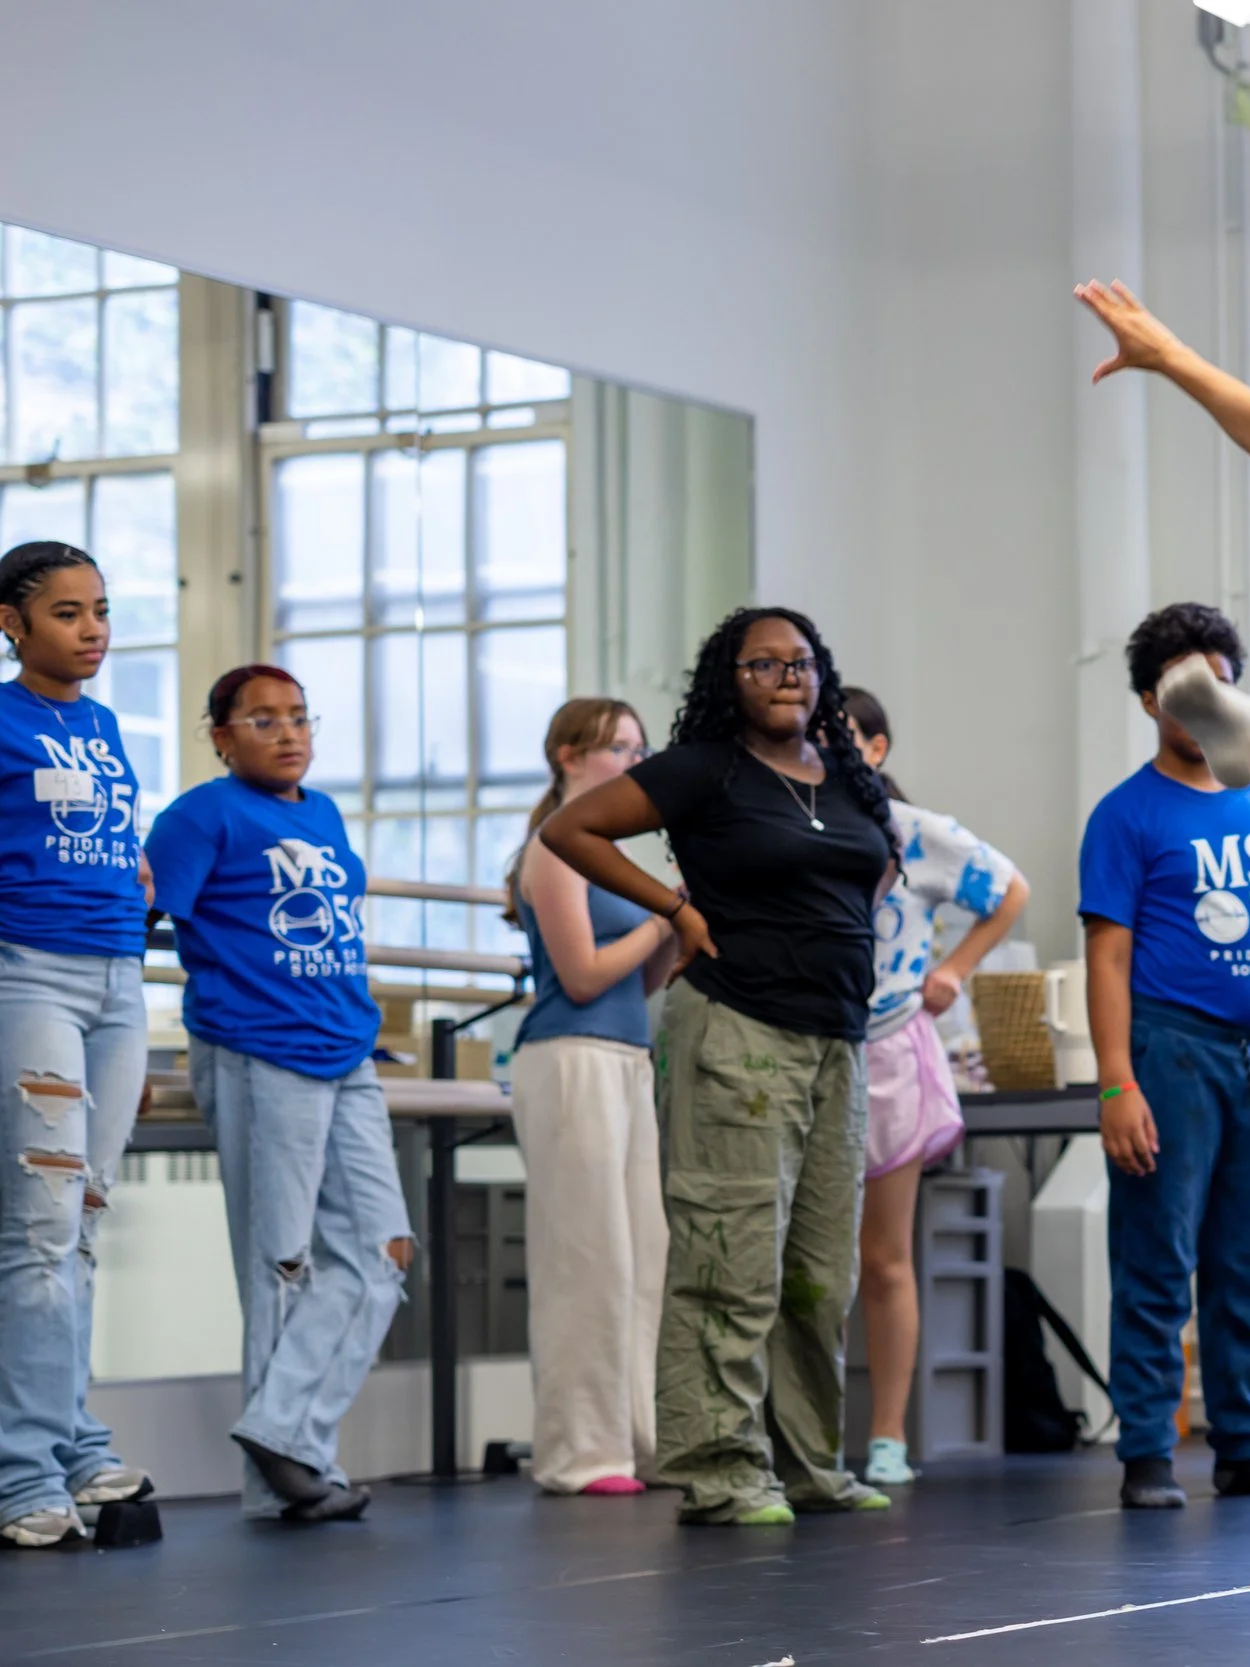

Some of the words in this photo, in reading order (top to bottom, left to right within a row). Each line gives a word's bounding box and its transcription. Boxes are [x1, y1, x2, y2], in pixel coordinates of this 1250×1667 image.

[33, 733, 125, 778] MS
[45, 834, 104, 853] PRIDE
[262, 845, 348, 894] MS
[273, 949, 336, 965] PRIDE
